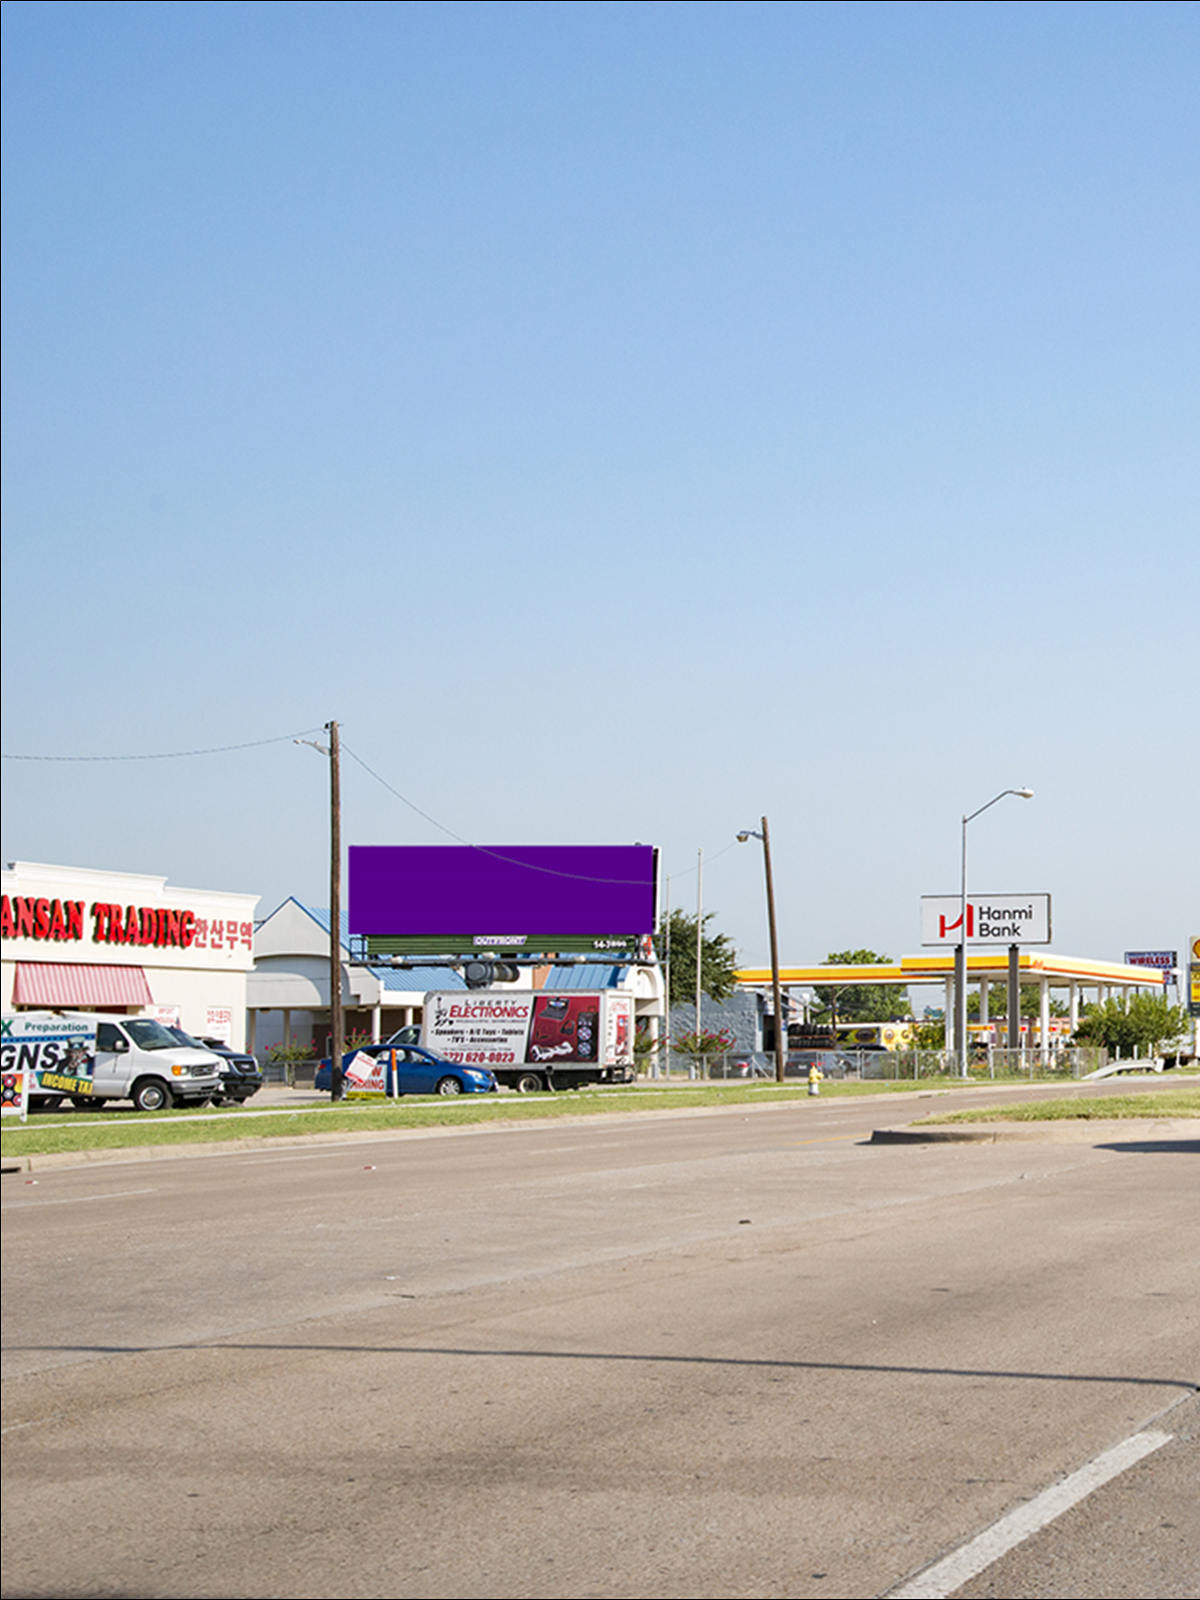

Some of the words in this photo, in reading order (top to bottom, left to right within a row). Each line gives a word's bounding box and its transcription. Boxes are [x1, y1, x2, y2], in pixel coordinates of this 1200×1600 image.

[979, 904, 1033, 920] Hanmi
[91, 902, 196, 949] TRADING
[979, 922, 1021, 937] Bank
[194, 918, 253, 951] 한산무역
[449, 1004, 530, 1018] ELECTRONICS
[25, 1021, 88, 1032] Preparation
[41, 1072, 78, 1092] INCOME
